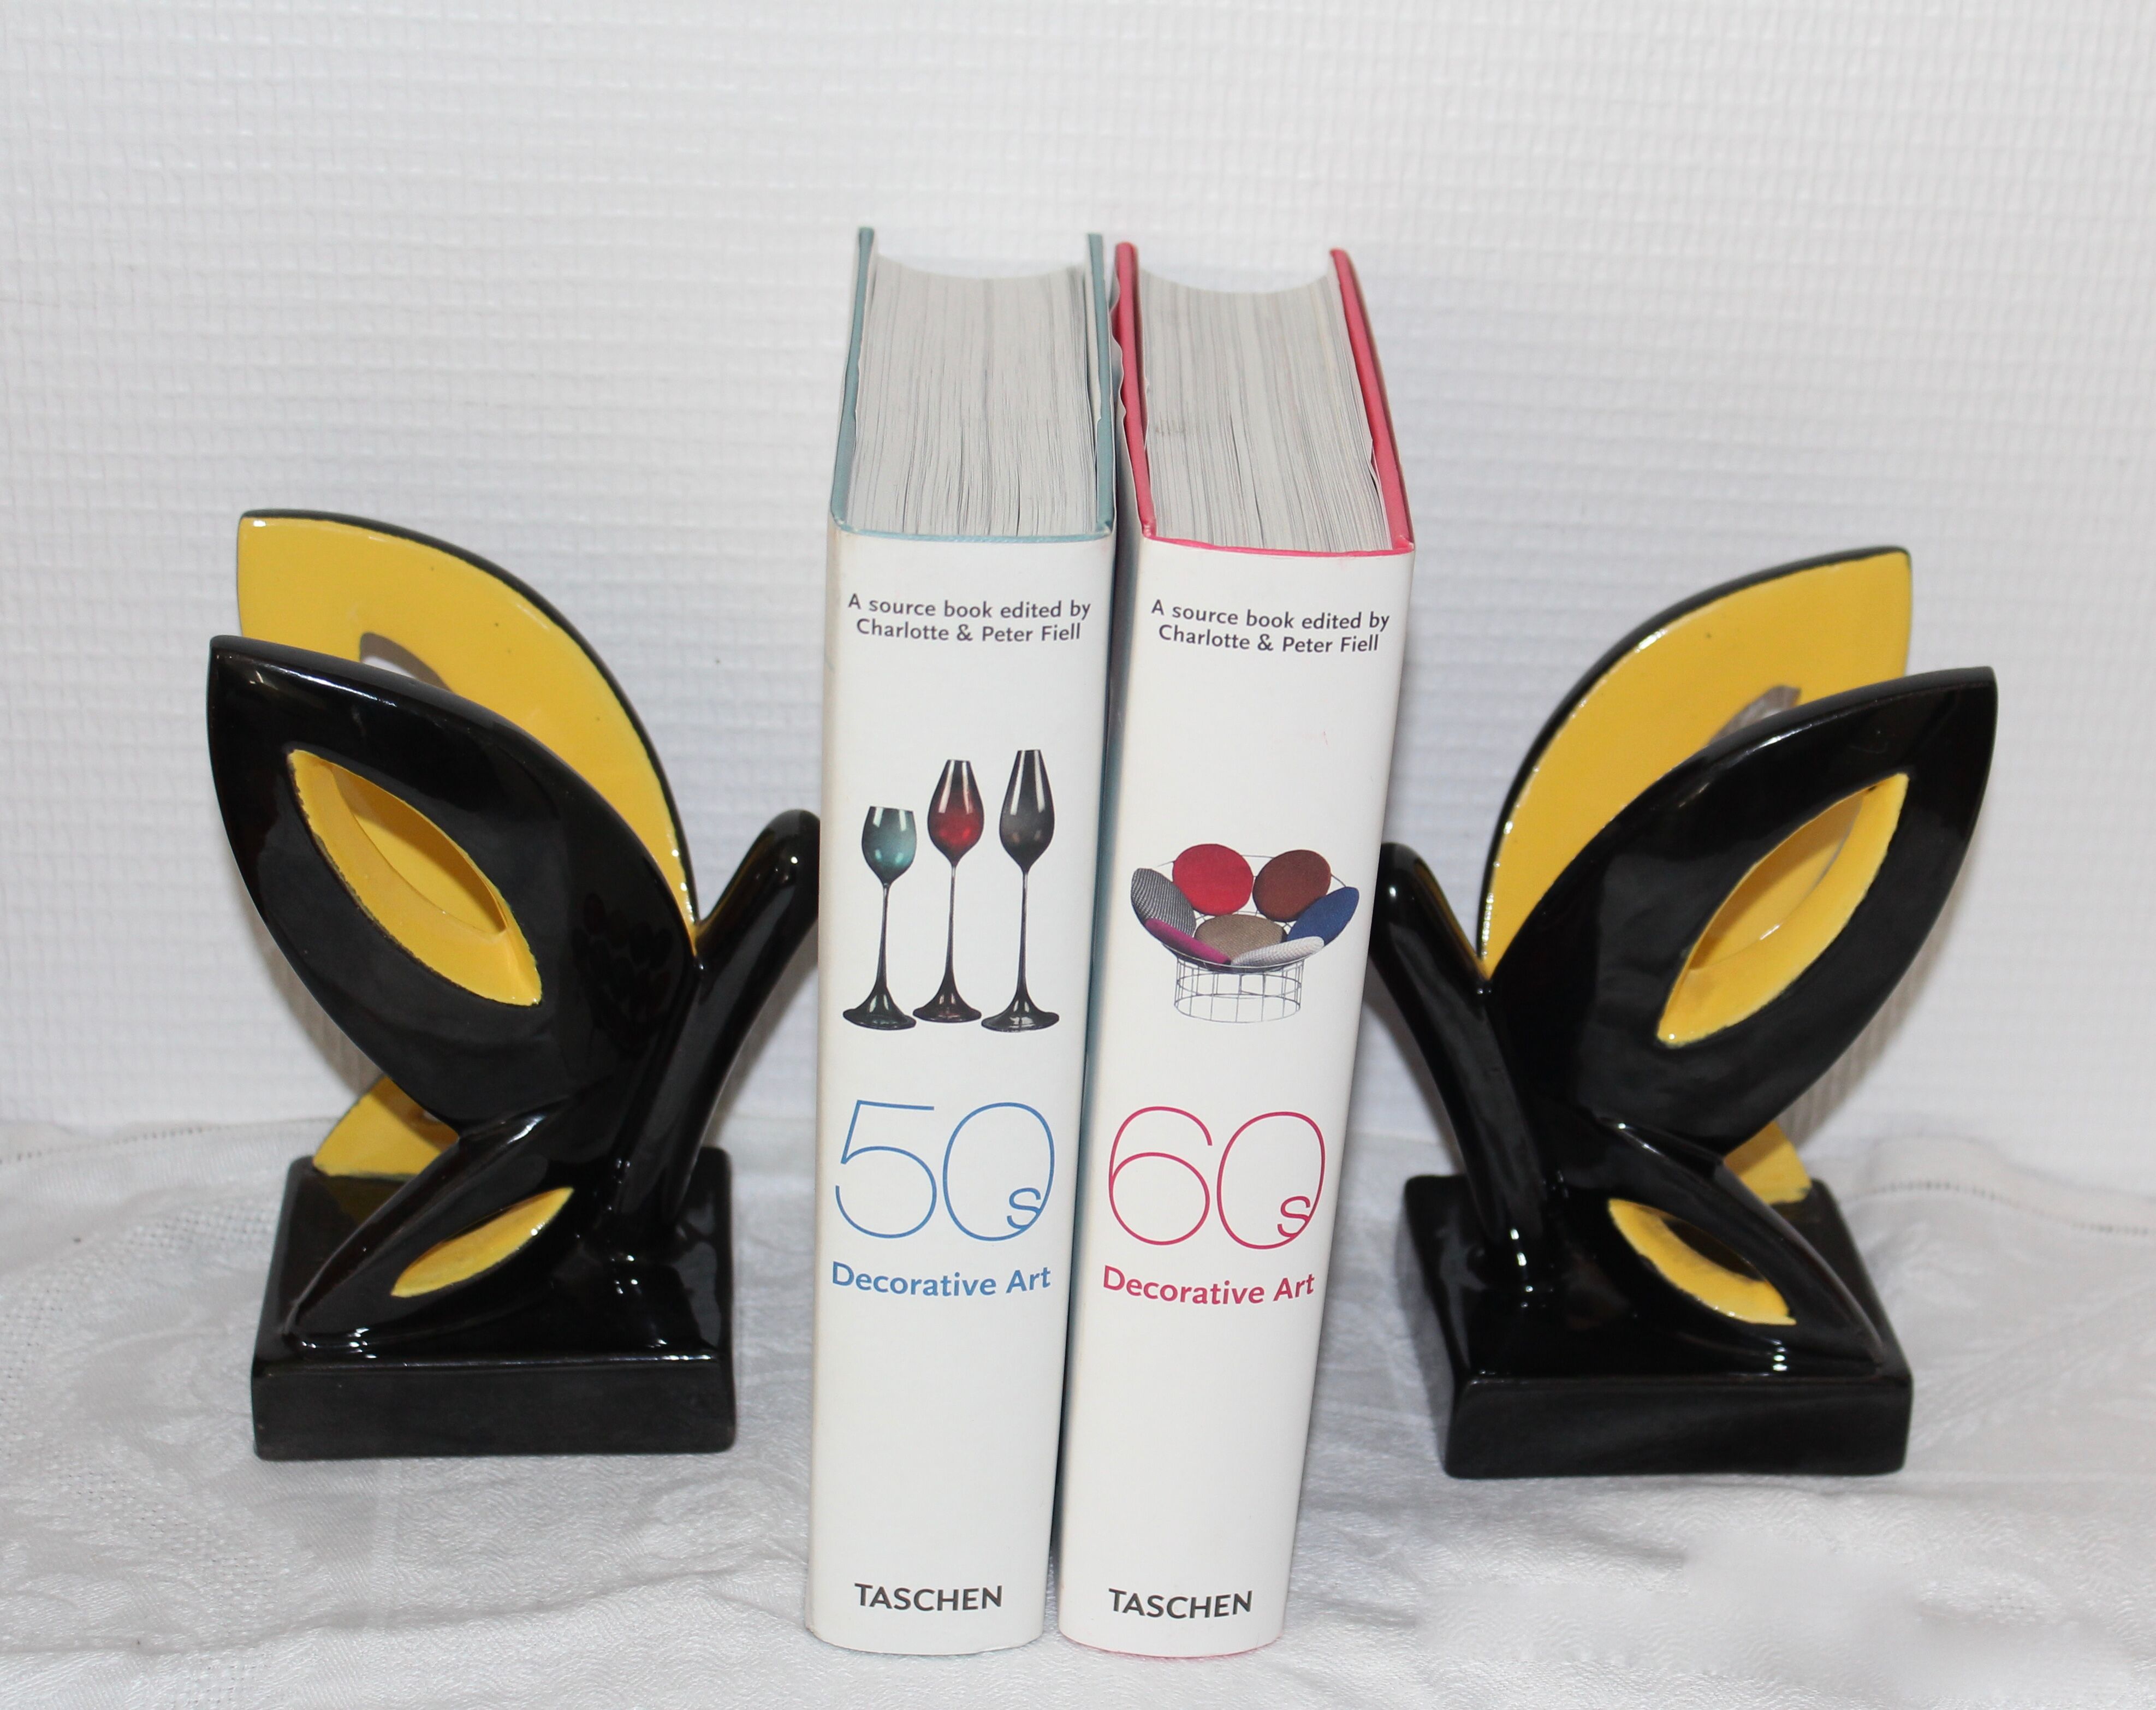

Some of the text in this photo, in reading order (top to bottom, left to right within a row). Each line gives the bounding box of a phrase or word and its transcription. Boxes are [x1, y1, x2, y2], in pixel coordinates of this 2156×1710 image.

[848, 593, 1091, 621] A source book edited by
[1151, 599, 1390, 632] A source book edited by
[856, 618, 1080, 642] Charlotte & Peter Fiell
[1159, 624, 1379, 653] Charlotte & Peter Fiell
[832, 1261, 1051, 1297] Decorative Art
[1103, 1265, 1315, 1305] Decorative Art
[854, 1583, 1002, 1612] TASCHEN
[1108, 1588, 1252, 1619] TASCHEN
